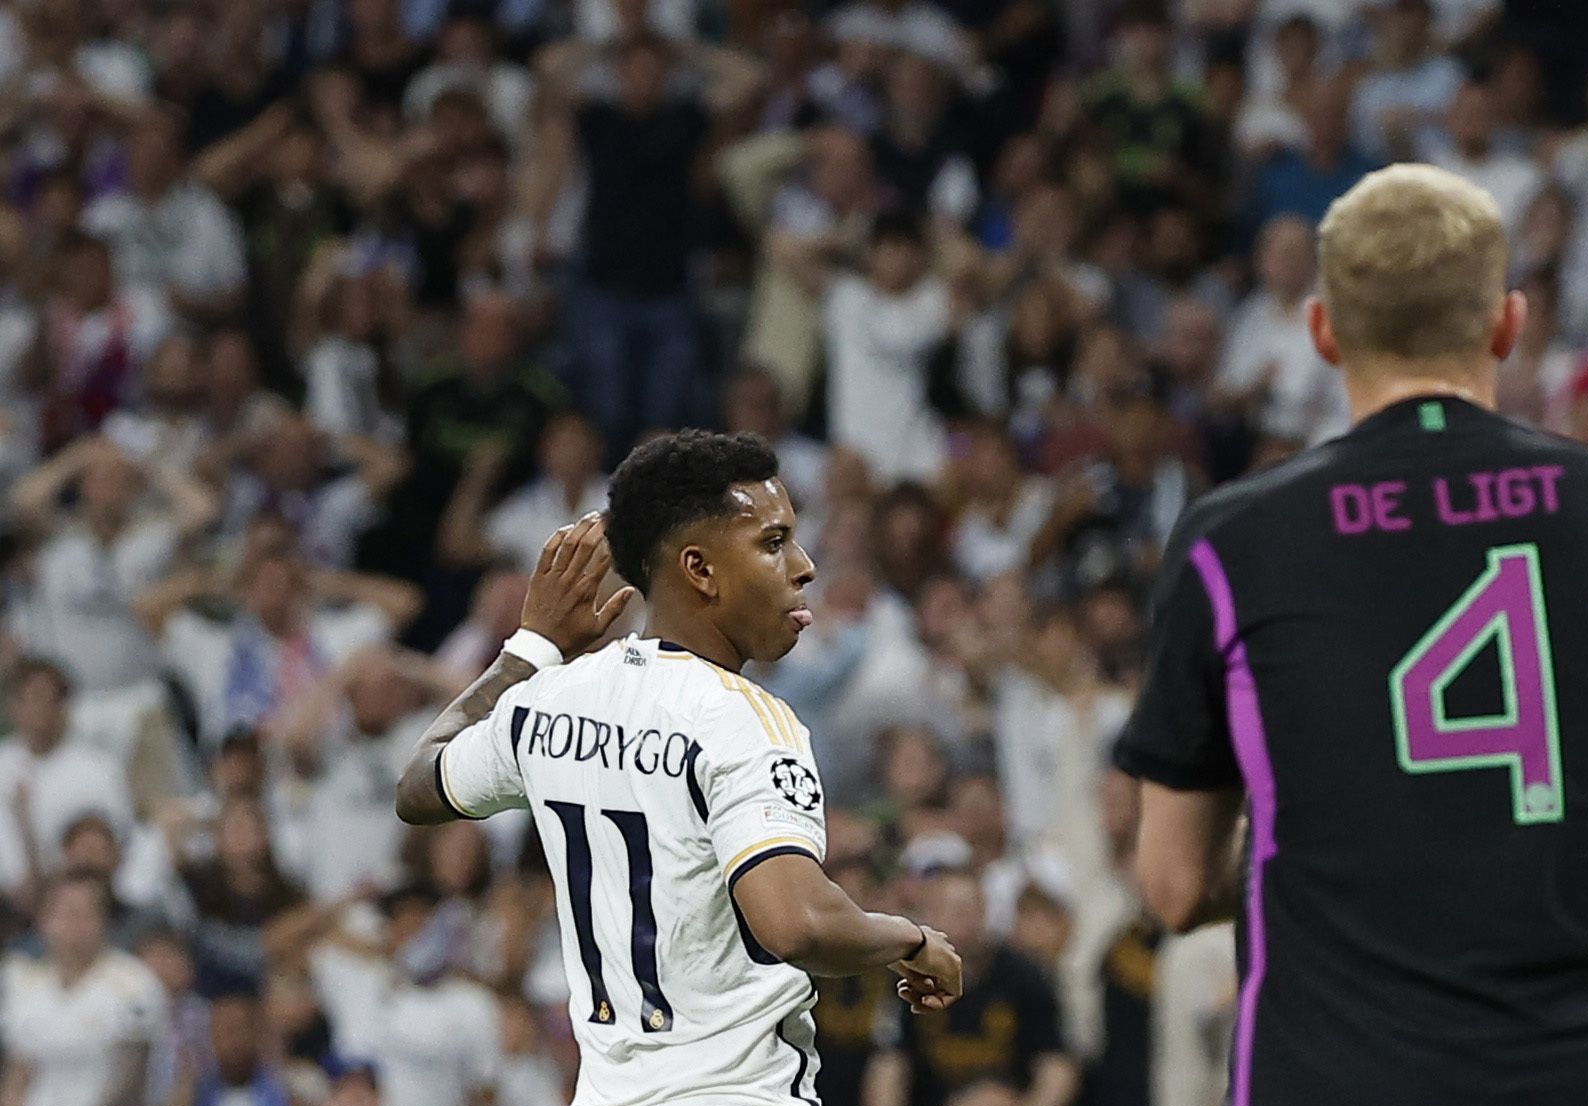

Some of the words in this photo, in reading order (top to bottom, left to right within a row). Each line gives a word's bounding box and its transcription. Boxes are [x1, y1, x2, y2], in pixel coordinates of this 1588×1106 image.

[1329, 480, 1413, 536] DE
[1433, 464, 1566, 526] LIGT
[527, 710, 688, 778] RODRYGO
[1388, 541, 1566, 827] 4
[543, 799, 674, 1034] 11
